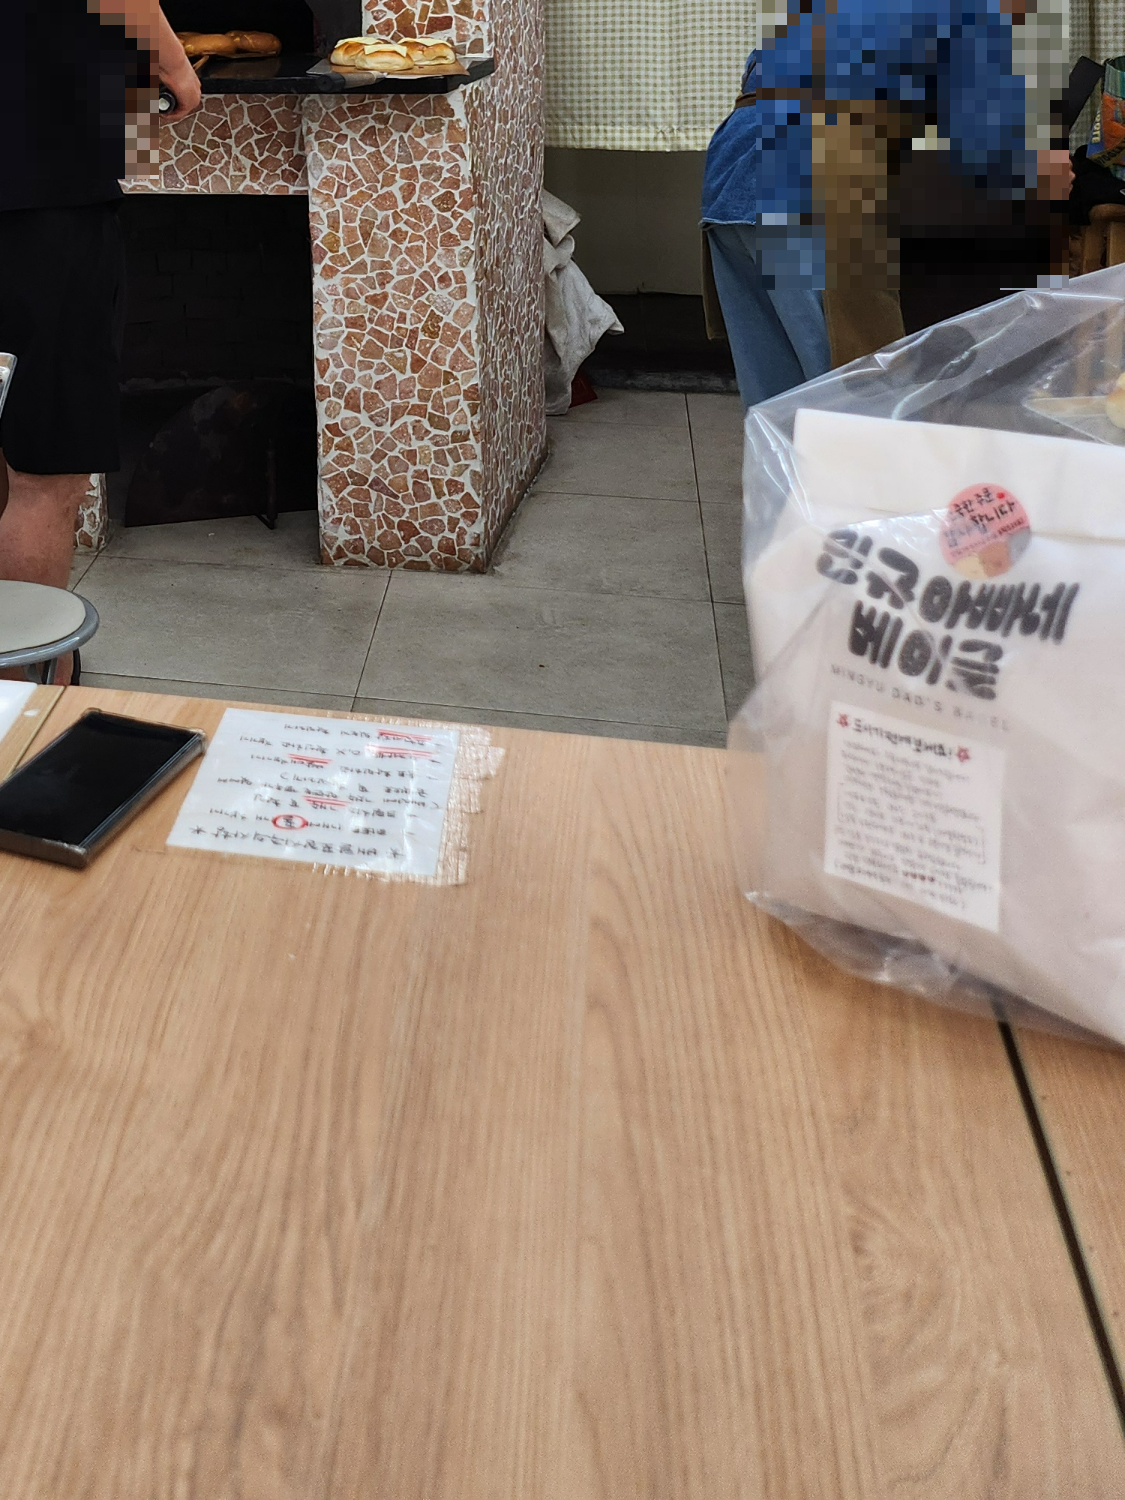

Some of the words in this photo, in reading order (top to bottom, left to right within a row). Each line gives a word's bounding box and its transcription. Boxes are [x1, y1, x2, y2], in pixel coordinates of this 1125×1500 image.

[817, 529, 1081, 646] 민규아빠네
[848, 600, 1004, 701] 베이글
[952, 705, 1011, 732] BAEL
